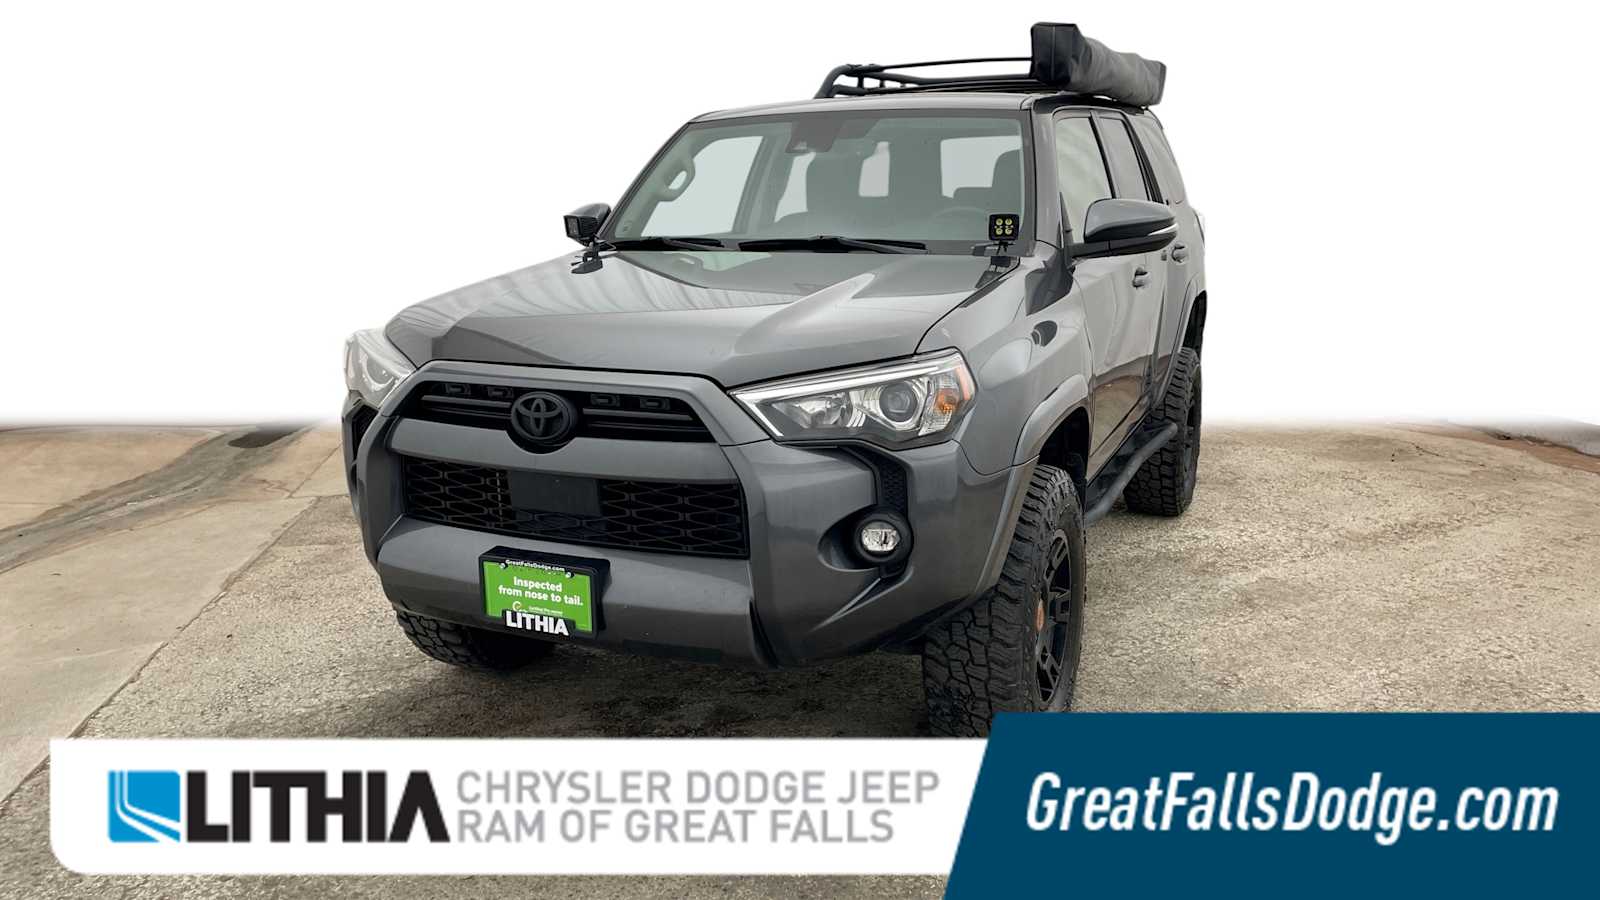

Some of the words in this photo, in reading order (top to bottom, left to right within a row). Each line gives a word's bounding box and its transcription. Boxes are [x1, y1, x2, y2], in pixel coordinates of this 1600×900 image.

[505, 559, 565, 572] GreatFallsDodge.com
[513, 576, 562, 592] Inspected
[498, 584, 522, 597] from
[524, 590, 548, 601] nose
[551, 592, 562, 603] to
[564, 594, 584, 606] tail.
[505, 610, 569, 636] LITHIA
